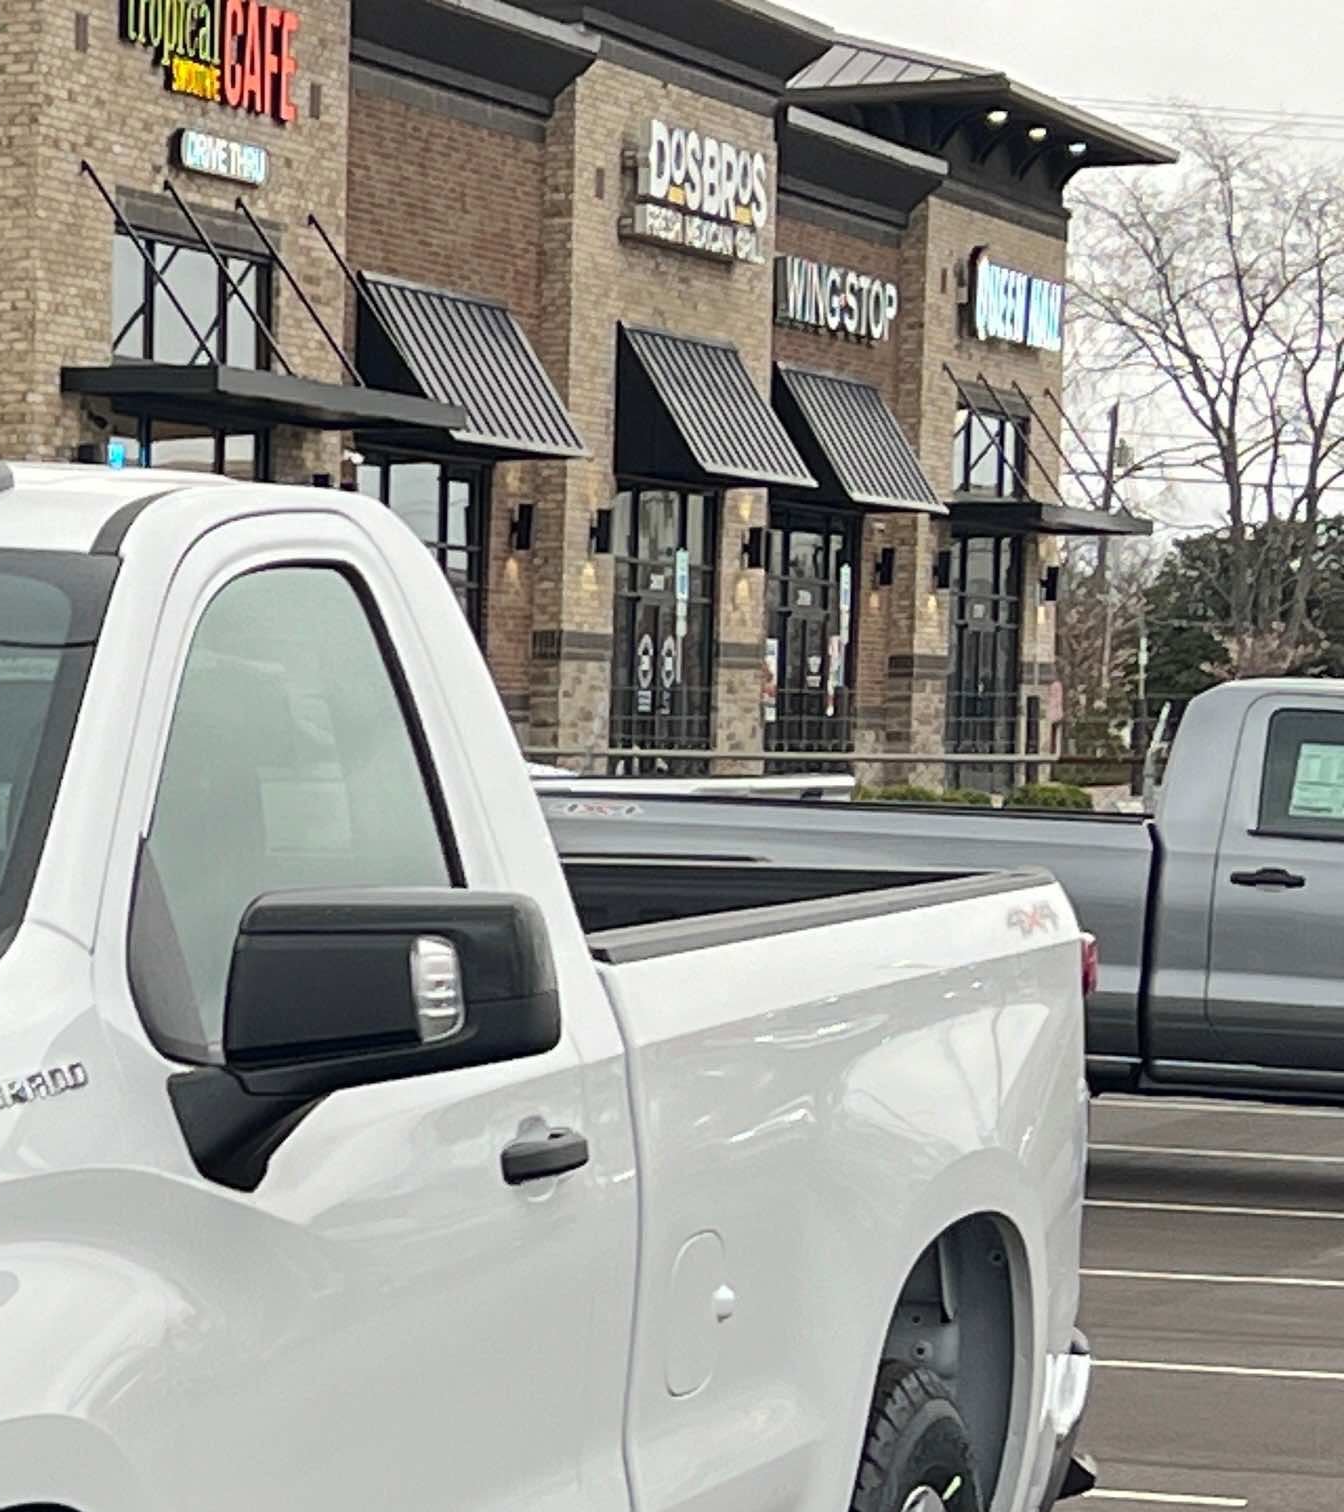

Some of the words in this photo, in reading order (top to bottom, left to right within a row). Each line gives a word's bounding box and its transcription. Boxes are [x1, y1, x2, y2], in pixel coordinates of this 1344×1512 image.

[224, 0, 300, 122] CAFE
[183, 131, 230, 175] DRIVE
[228, 142, 267, 184] THRU
